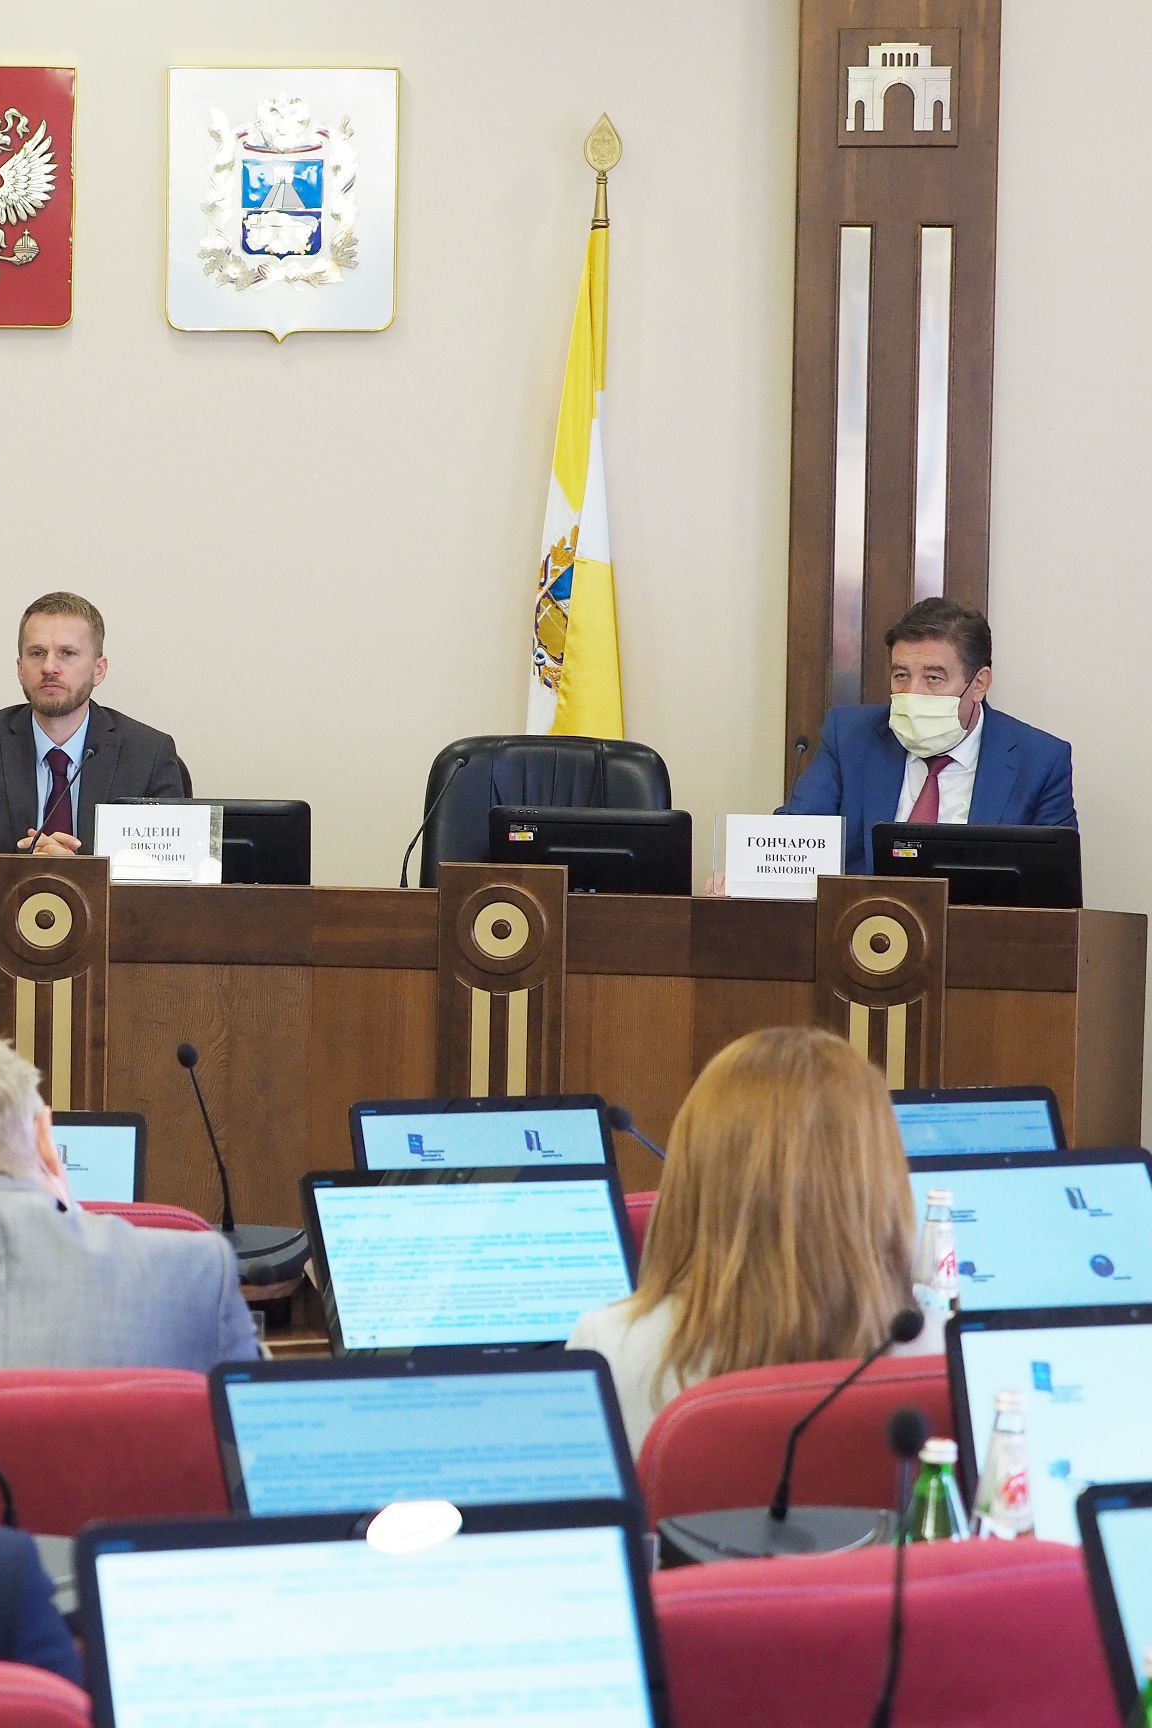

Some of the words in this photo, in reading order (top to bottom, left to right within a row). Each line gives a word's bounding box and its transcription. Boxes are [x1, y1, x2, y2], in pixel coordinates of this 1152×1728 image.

[121, 826, 181, 839] НАДЕИН
[129, 841, 173, 851] ВИКТОР
[746, 836, 827, 850] ГОНЧАРОВ
[764, 853, 808, 863] ВИКТОР
[755, 865, 816, 875] ИВАНОВИЧ
